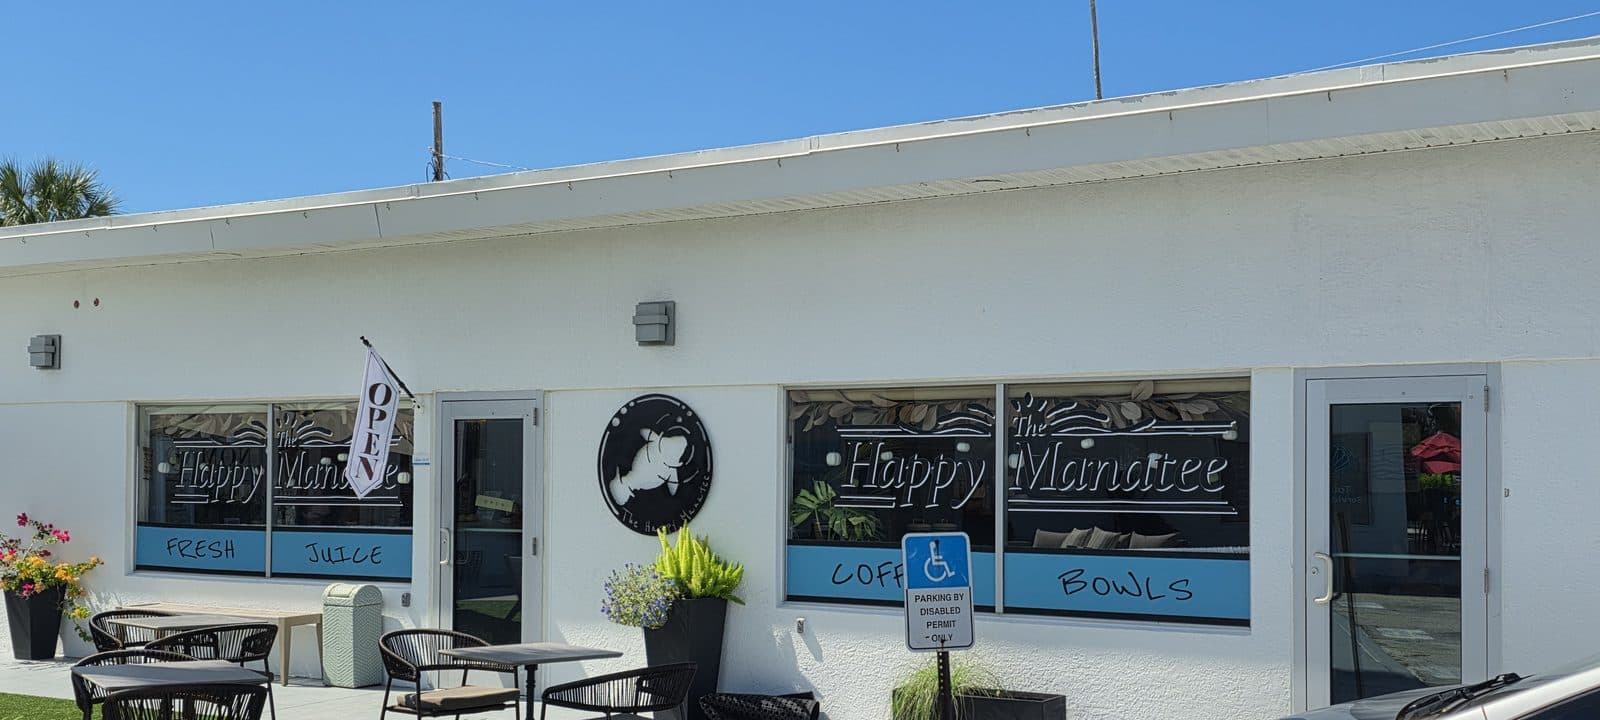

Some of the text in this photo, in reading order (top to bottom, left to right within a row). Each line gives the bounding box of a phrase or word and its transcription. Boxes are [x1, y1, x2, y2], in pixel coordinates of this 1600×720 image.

[355, 382, 392, 481] OPEN
[1013, 416, 1047, 438] The
[277, 430, 298, 448] The
[175, 451, 399, 504] Happy Manae
[840, 441, 1228, 509] Happy Manatee
[623, 507, 638, 528] The
[166, 537, 383, 565] FRESH JUICE
[832, 561, 1193, 600] COFF BOWLS
[914, 593, 965, 603] PARKING BY
[920, 607, 961, 616] DISABLED
[926, 620, 956, 629] PERMIT
[931, 633, 953, 642] ONLY
